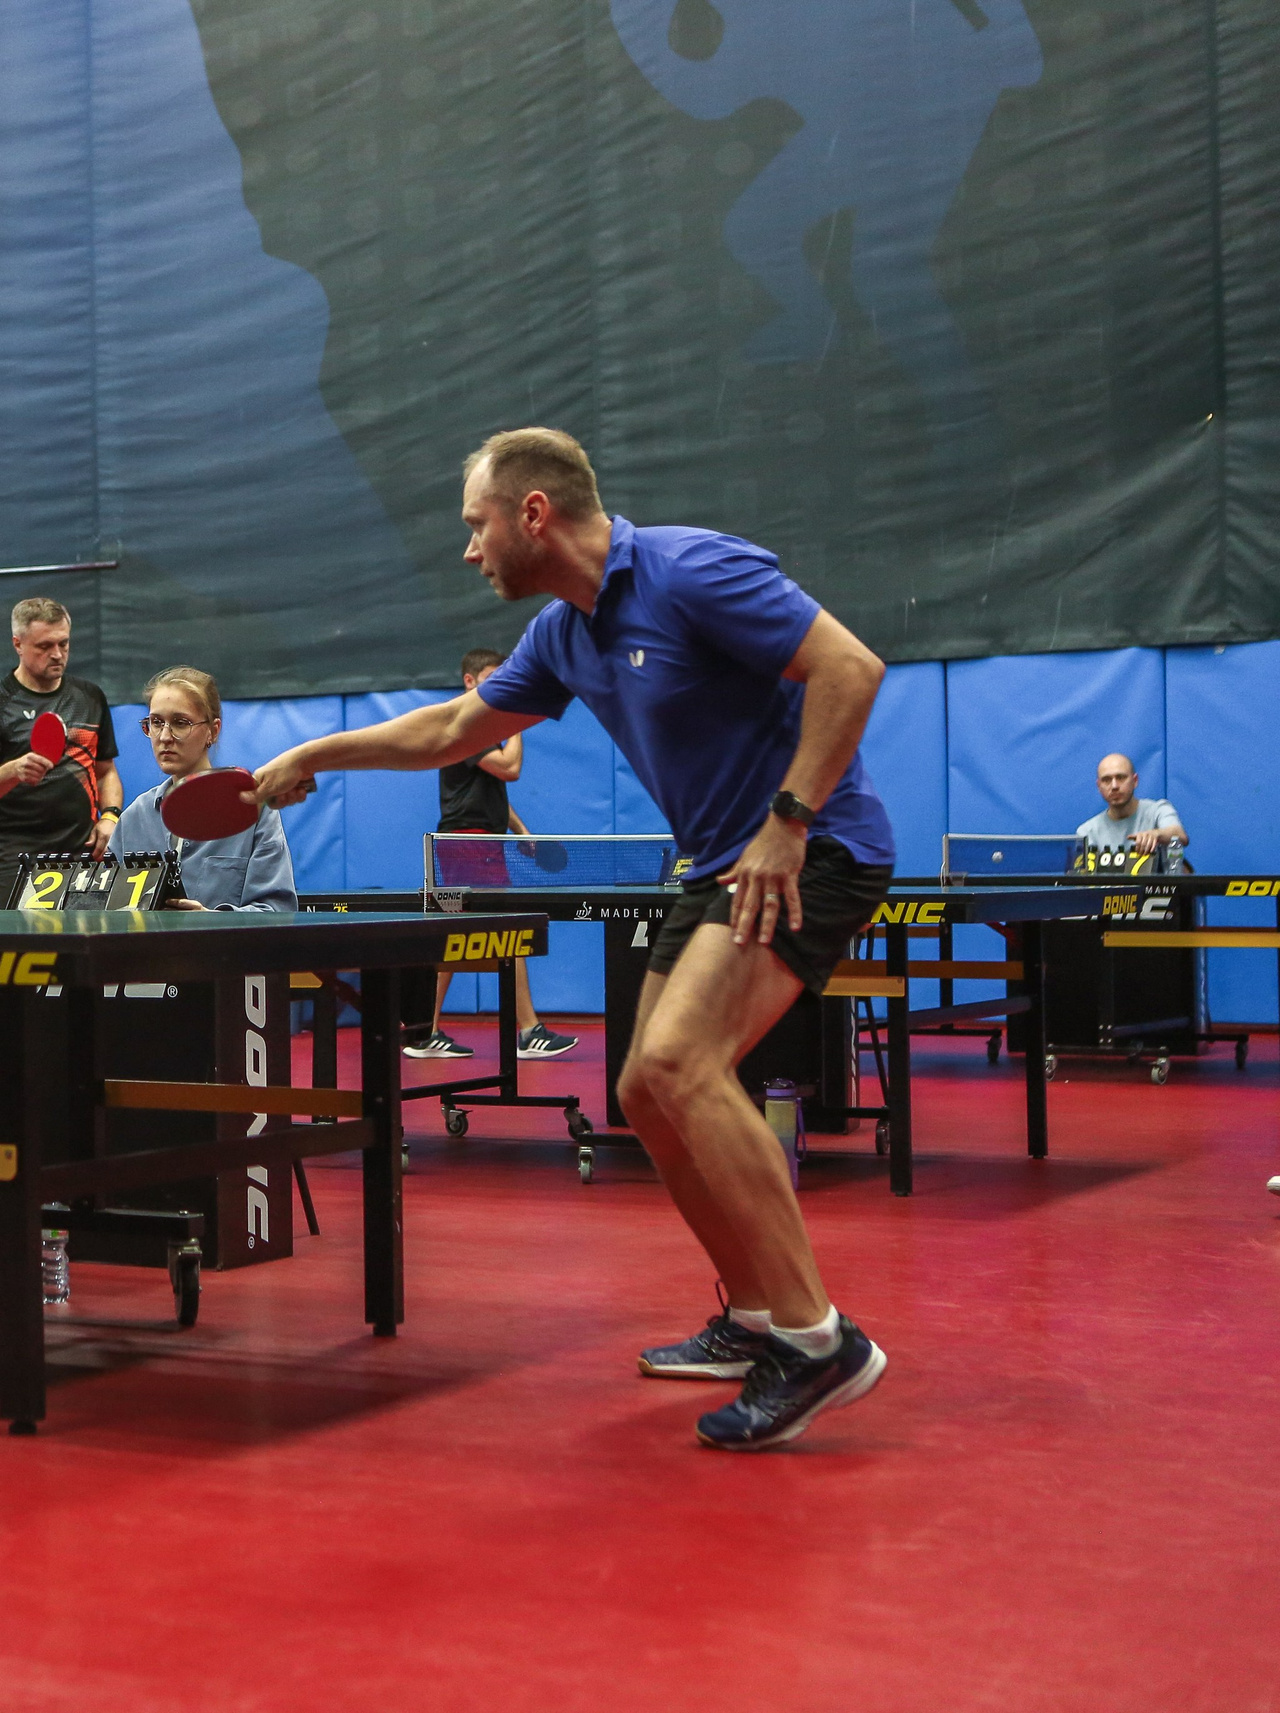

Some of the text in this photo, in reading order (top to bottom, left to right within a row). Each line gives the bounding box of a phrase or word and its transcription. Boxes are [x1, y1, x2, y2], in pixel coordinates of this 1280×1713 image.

[1129, 852, 1150, 876] 7
[23, 871, 64, 909] 2
[99, 870, 111, 890] 1
[126, 870, 149, 908] 1
[437, 892, 461, 900] DONIC
[1145, 886, 1177, 894] MANY
[600, 908, 663, 918] MADE IN
[870, 902, 946, 923] NIC
[1103, 895, 1138, 915] DONIC
[443, 930, 534, 962] DONIC
